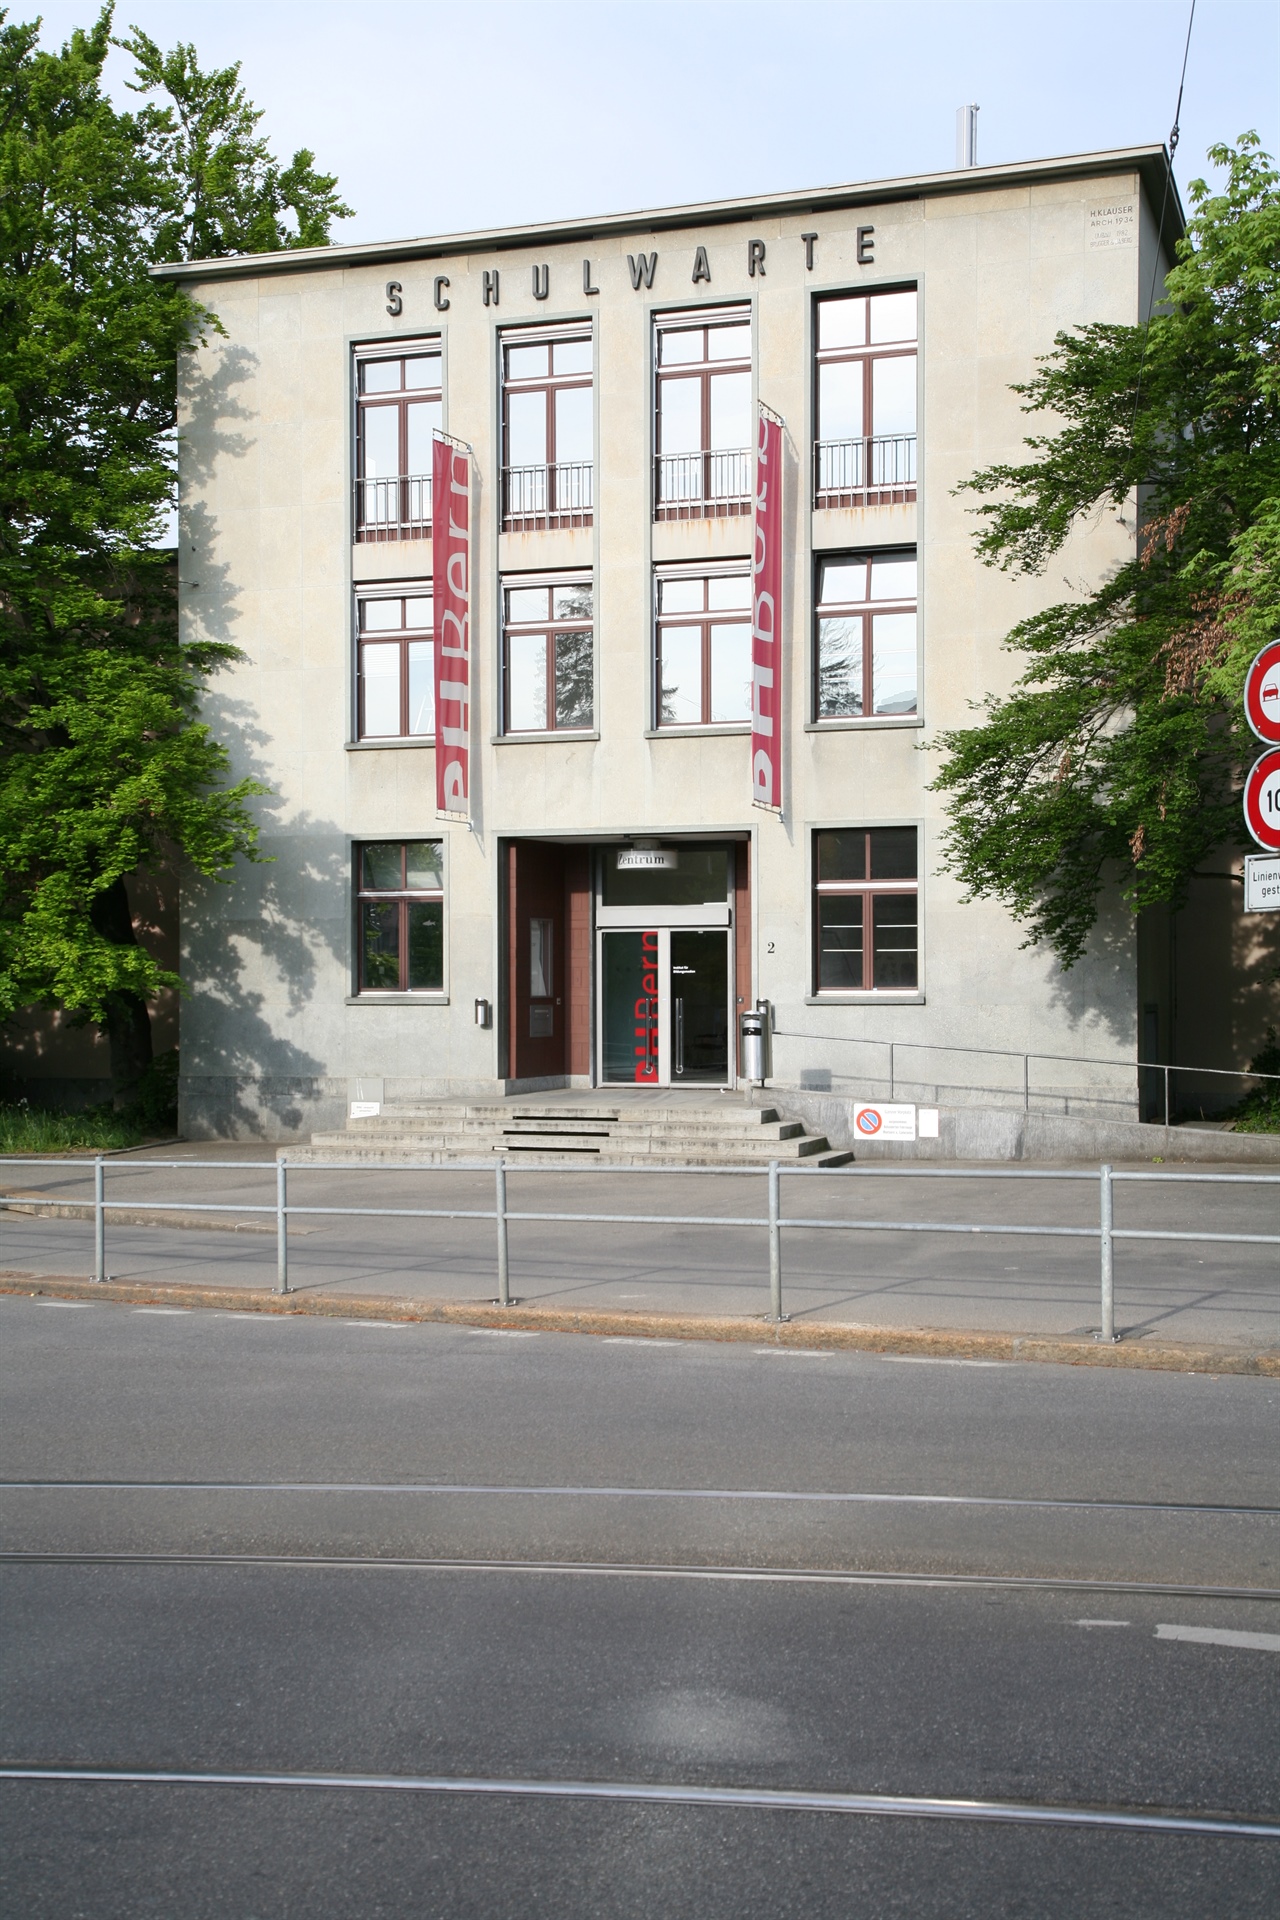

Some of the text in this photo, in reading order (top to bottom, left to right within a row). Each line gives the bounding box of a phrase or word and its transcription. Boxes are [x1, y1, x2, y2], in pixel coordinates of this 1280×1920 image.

[1115, 217, 1133, 225] 1934
[386, 225, 874, 316] SCHULWARTE
[767, 941, 775, 953] 2
